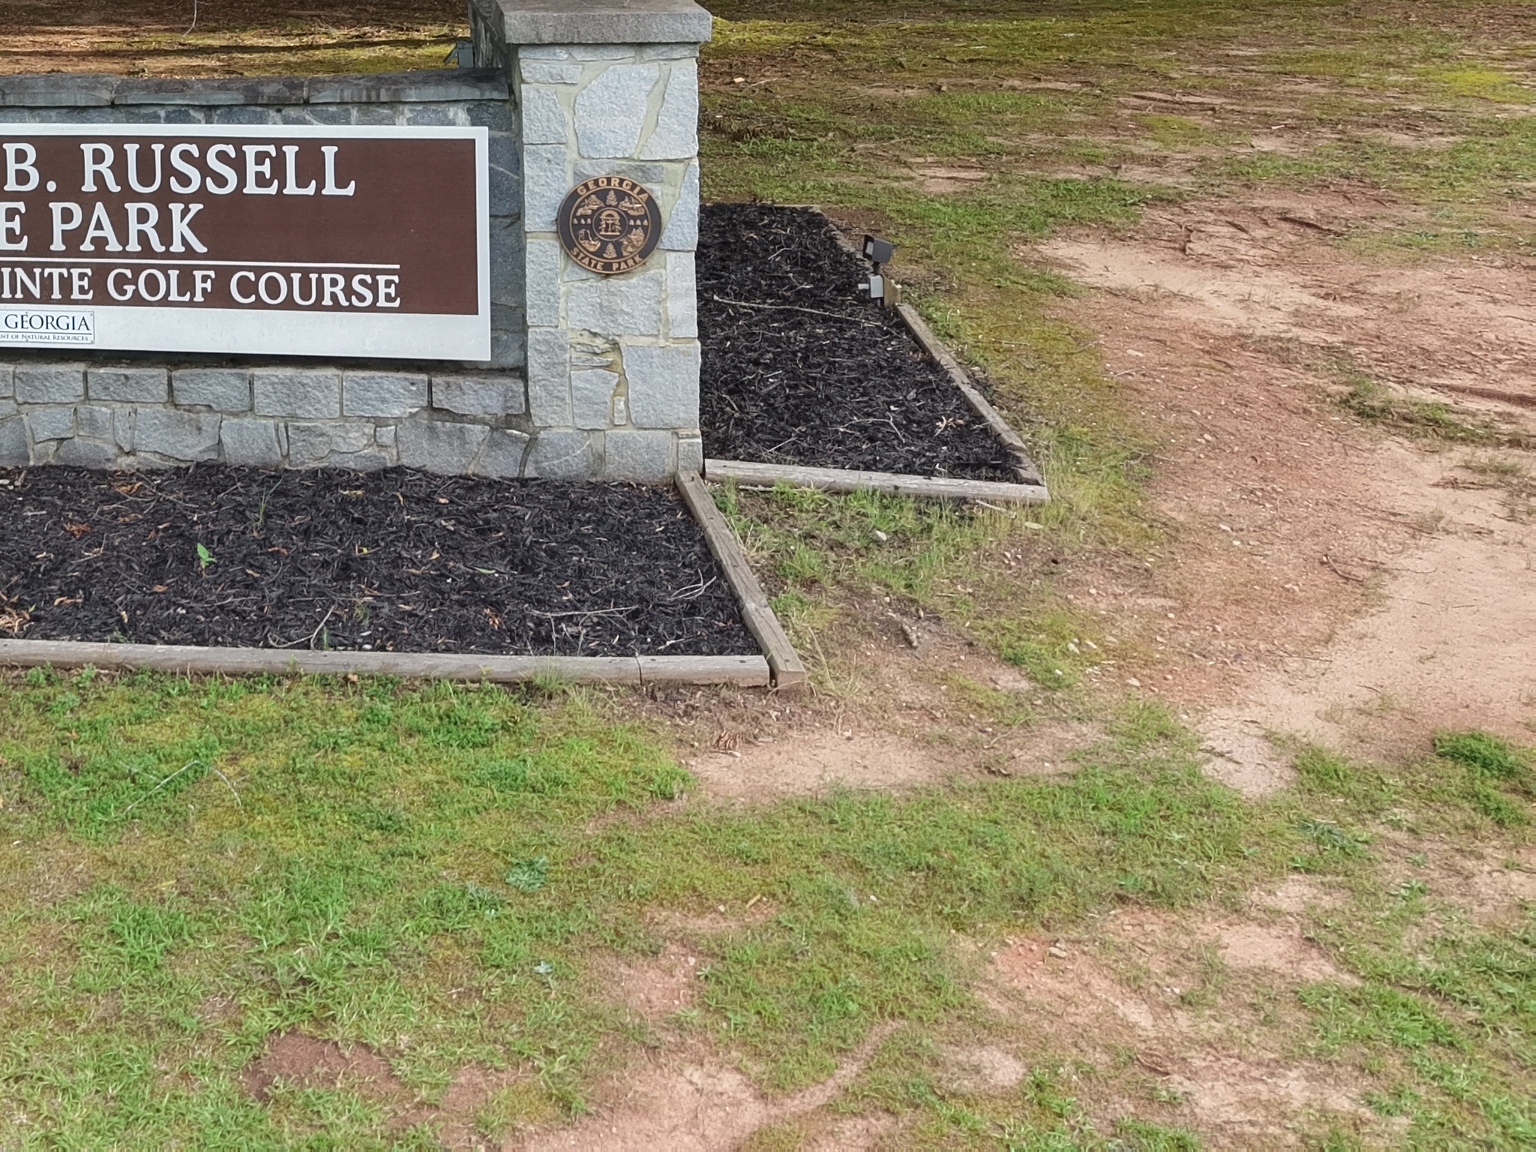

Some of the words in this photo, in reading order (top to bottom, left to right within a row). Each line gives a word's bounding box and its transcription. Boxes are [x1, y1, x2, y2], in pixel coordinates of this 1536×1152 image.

[3, 143, 56, 192] B.
[80, 143, 355, 196] RUSSELL
[577, 178, 649, 202] GEORGIA
[49, 202, 207, 253] PARK
[570, 247, 604, 271] STATE
[612, 254, 643, 271] PARK
[107, 269, 215, 301] GOLF
[230, 271, 401, 307] COURSE
[4, 313, 90, 331] GEORGIA
